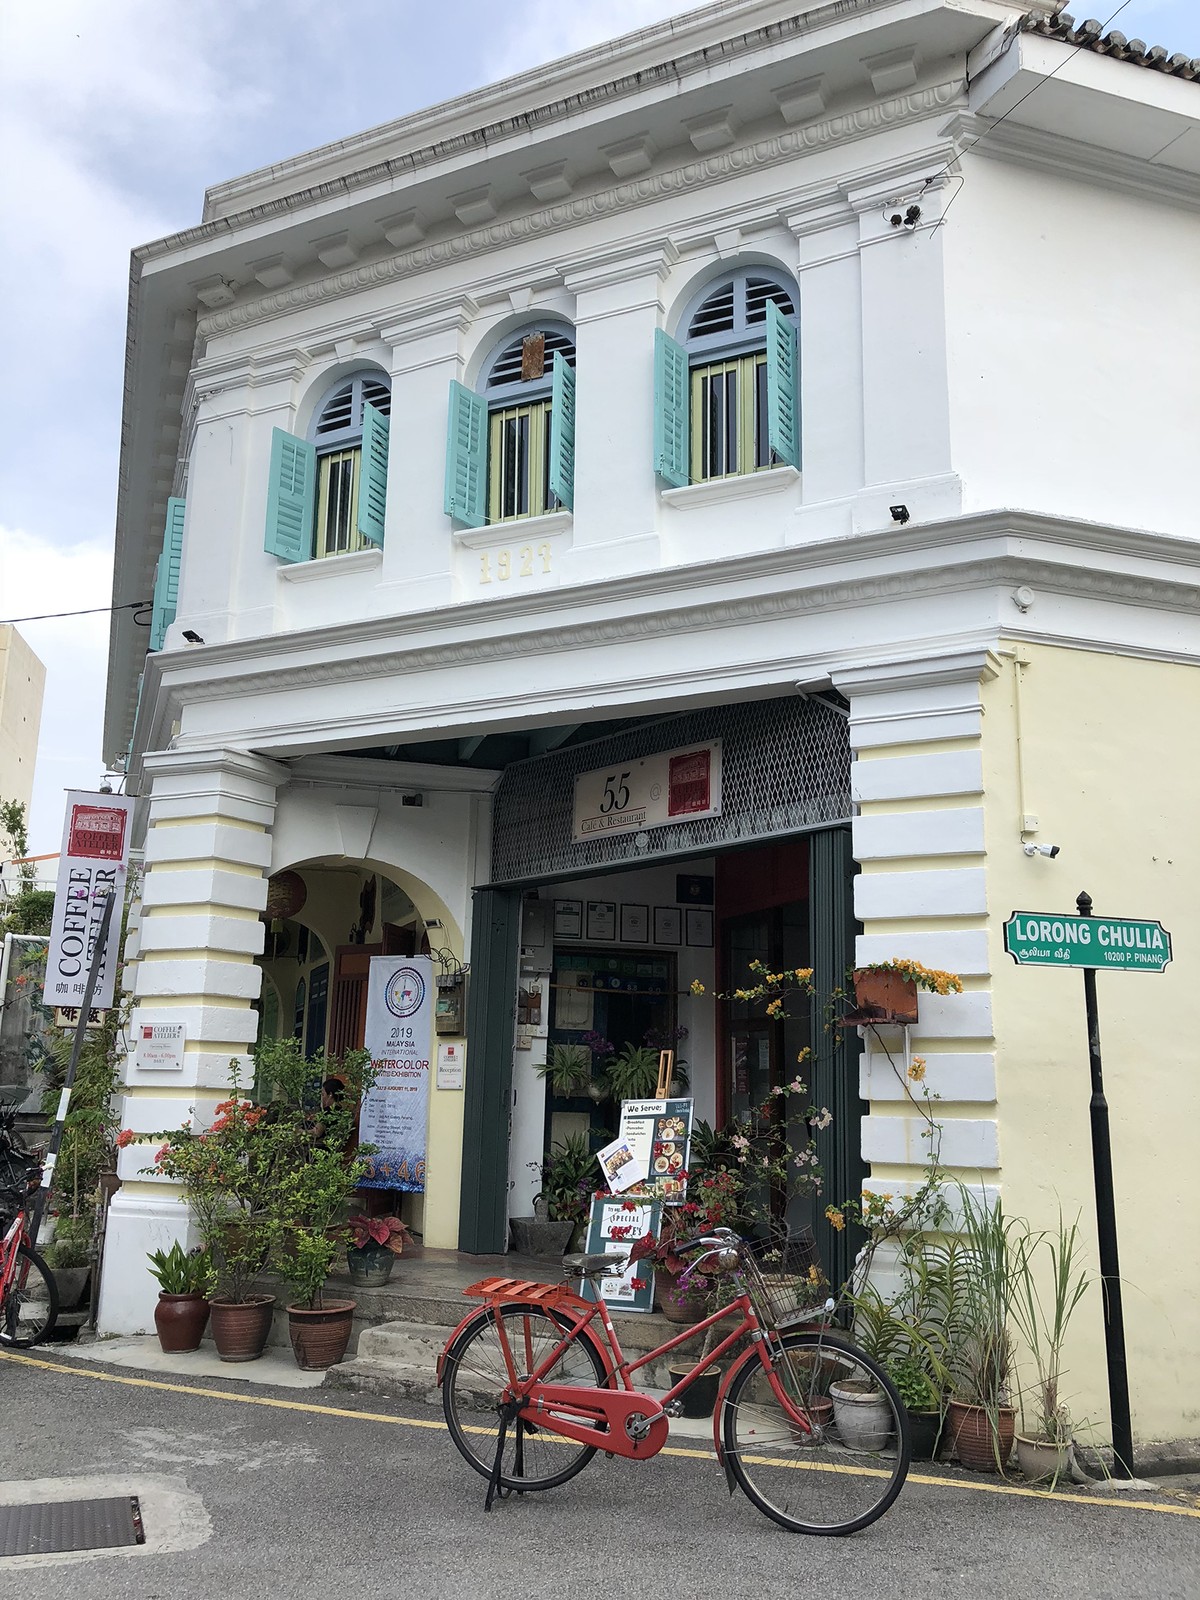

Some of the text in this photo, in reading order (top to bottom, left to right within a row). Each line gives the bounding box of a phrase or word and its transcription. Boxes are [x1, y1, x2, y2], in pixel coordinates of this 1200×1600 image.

[600, 772, 631, 813] 55
[607, 811, 646, 827] Restaurant
[76, 831, 118, 842] COFFEE
[75, 840, 118, 850] ATELIER
[58, 868, 92, 978] COFFEE
[1015, 919, 1164, 949] LORONG CHULIA
[1104, 951, 1163, 964] 10200 P. PINANG
[439, 1066, 462, 1074] Reception
[627, 1105, 639, 1113] We
[612, 1215, 639, 1223] SPECIAL
